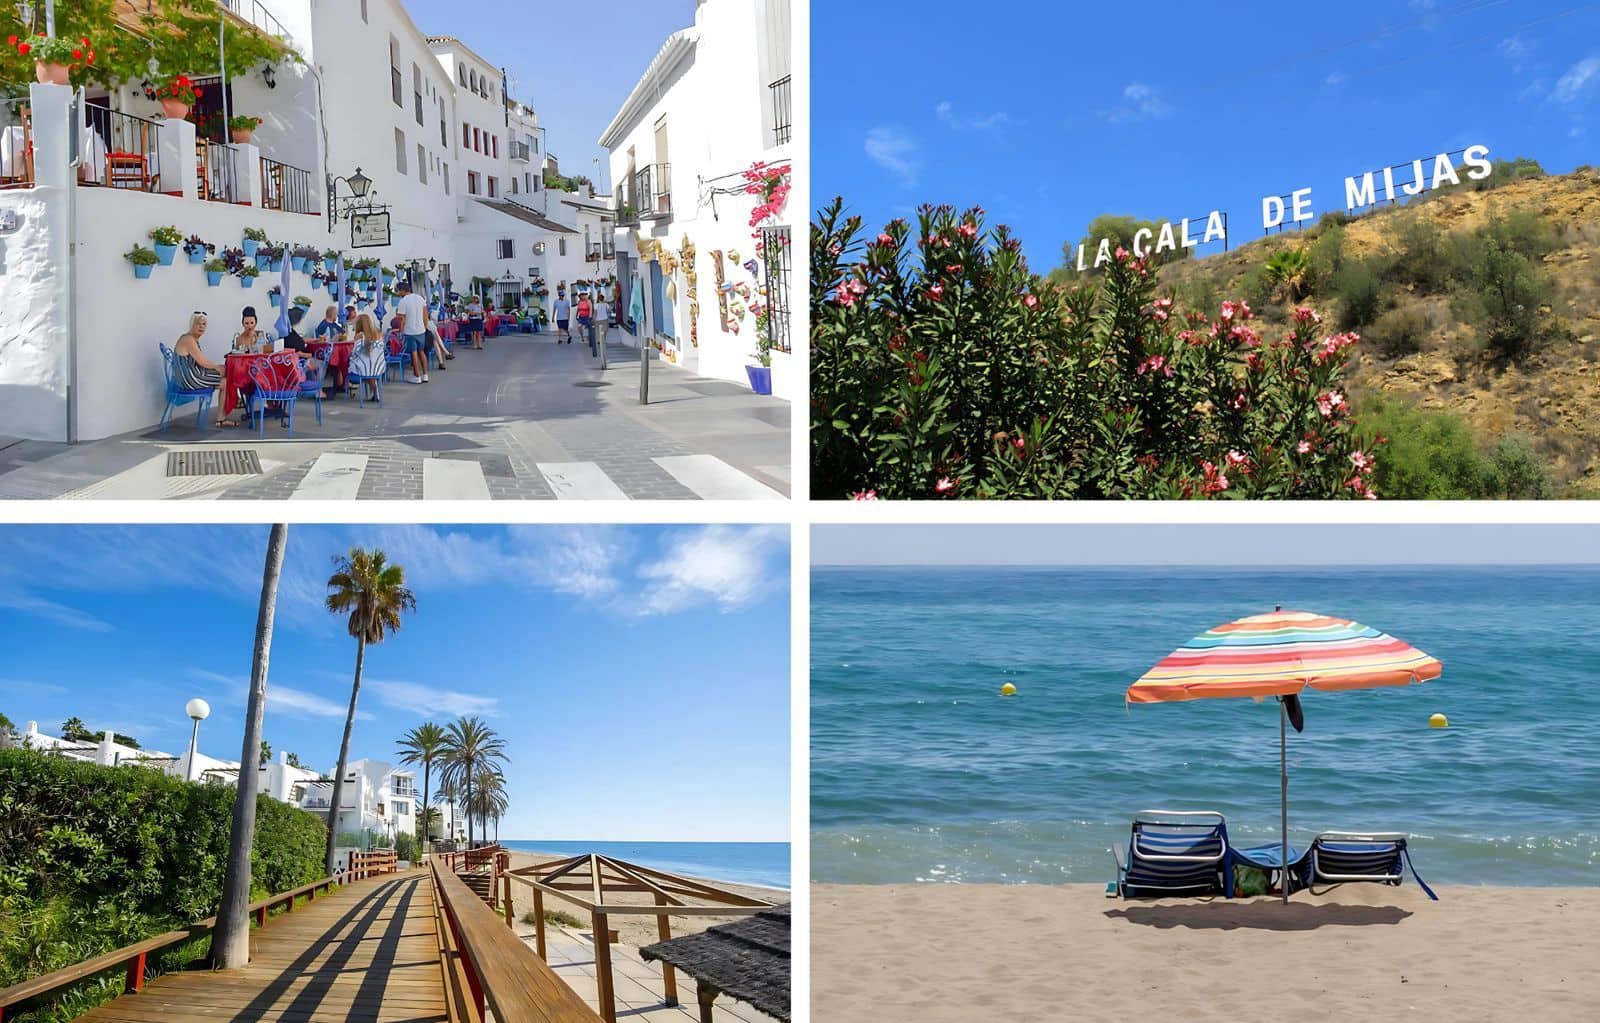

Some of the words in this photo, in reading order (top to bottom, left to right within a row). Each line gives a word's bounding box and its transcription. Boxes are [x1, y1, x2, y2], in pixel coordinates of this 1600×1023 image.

[1077, 238, 1111, 271] LA
[1133, 210, 1226, 258] CALA
[1262, 187, 1314, 228] DE
[1344, 144, 1493, 209] MIJAS
